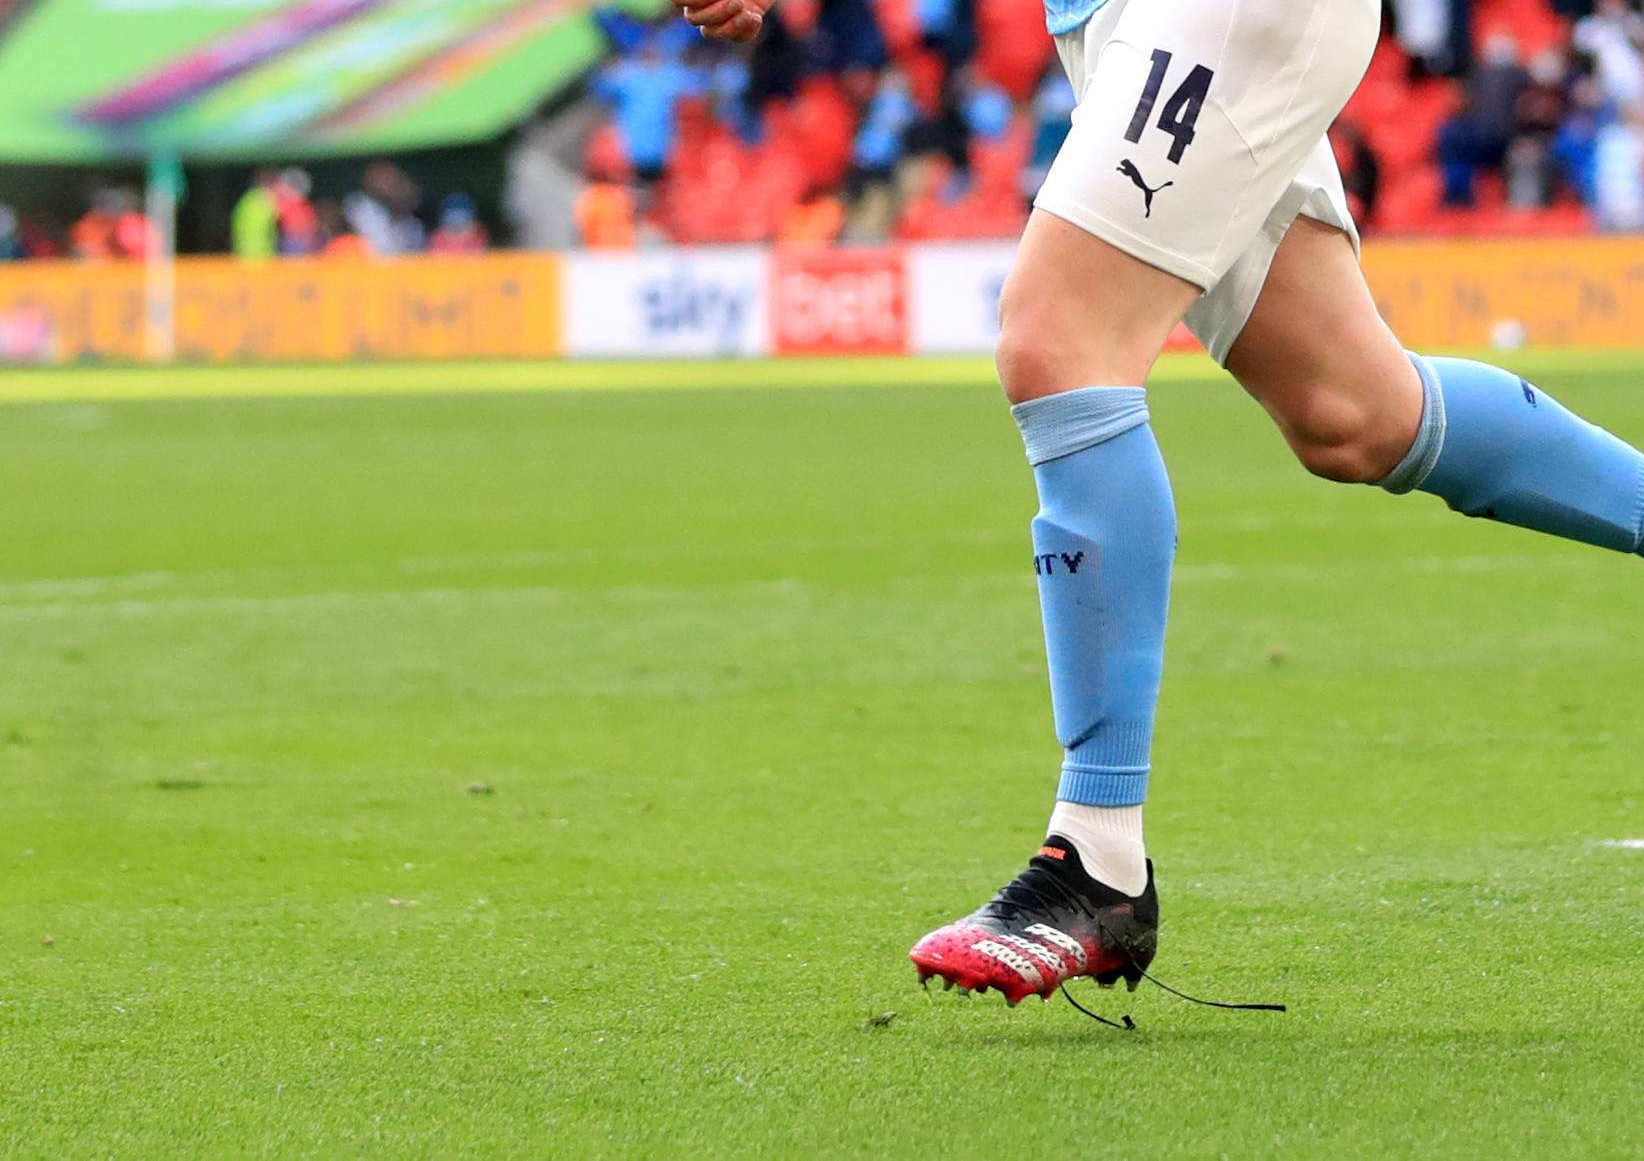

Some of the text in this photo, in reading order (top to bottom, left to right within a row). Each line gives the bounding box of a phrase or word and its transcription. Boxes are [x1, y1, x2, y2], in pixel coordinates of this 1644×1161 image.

[1123, 48, 1214, 165] 14
[638, 260, 748, 351] sky
[780, 266, 903, 345] bet
